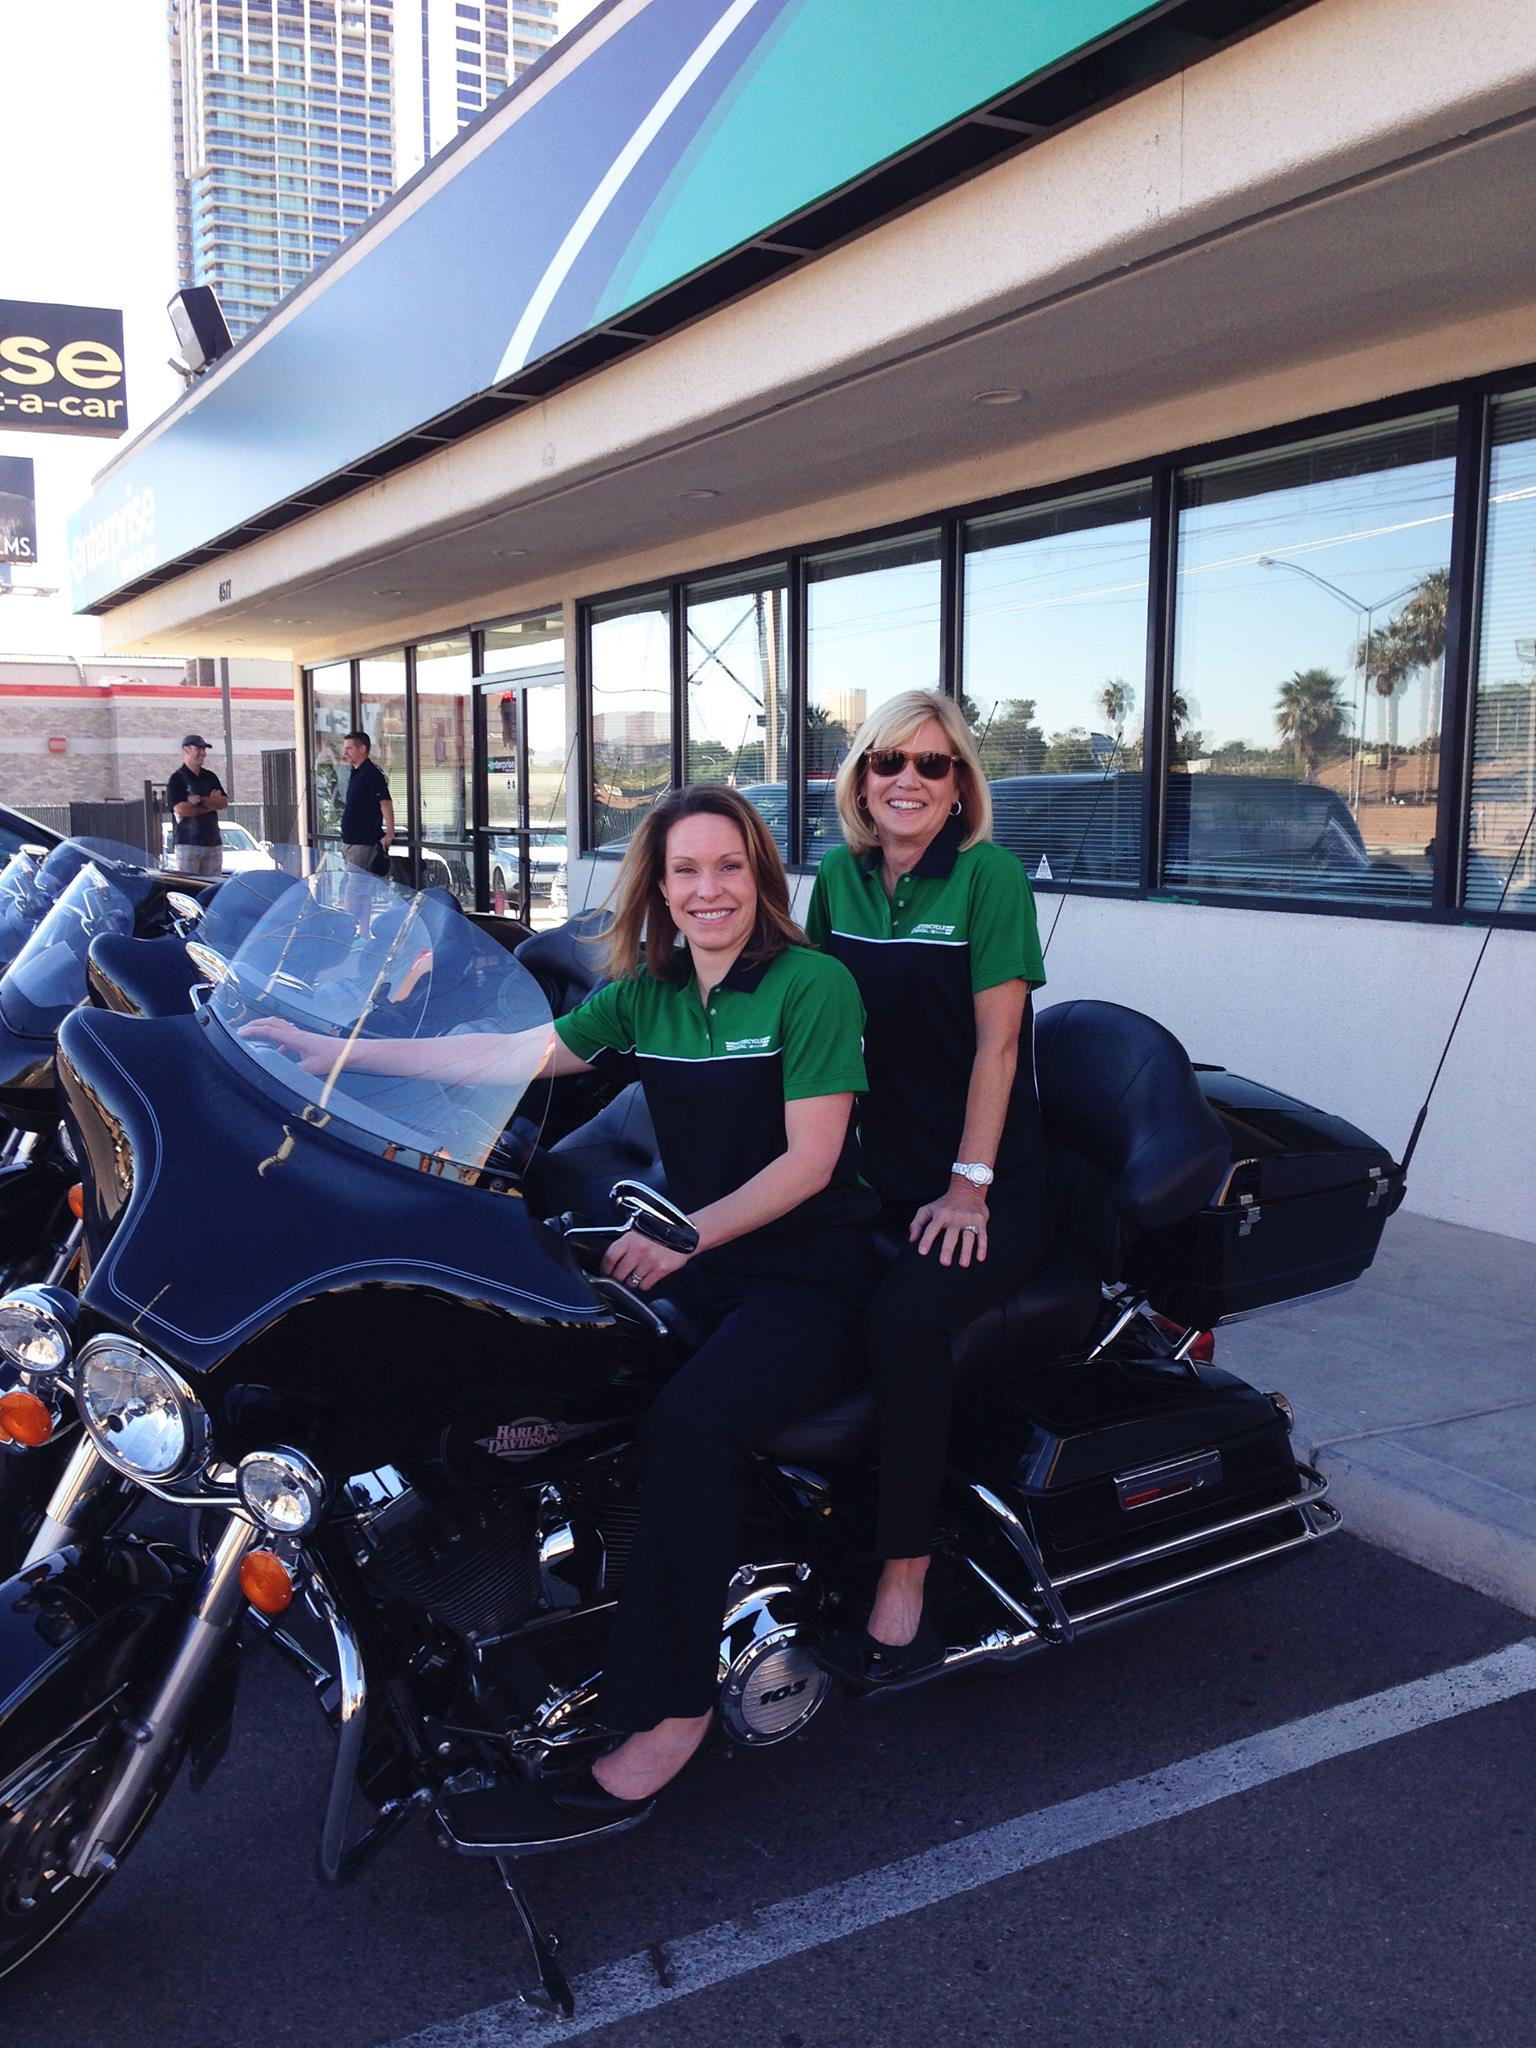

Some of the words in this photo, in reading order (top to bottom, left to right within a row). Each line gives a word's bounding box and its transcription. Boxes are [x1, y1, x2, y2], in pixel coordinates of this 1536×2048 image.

[0, 535, 35, 557] MS.
[487, 1432, 560, 1454] DAVIDSON
[760, 1678, 808, 1705] 103
